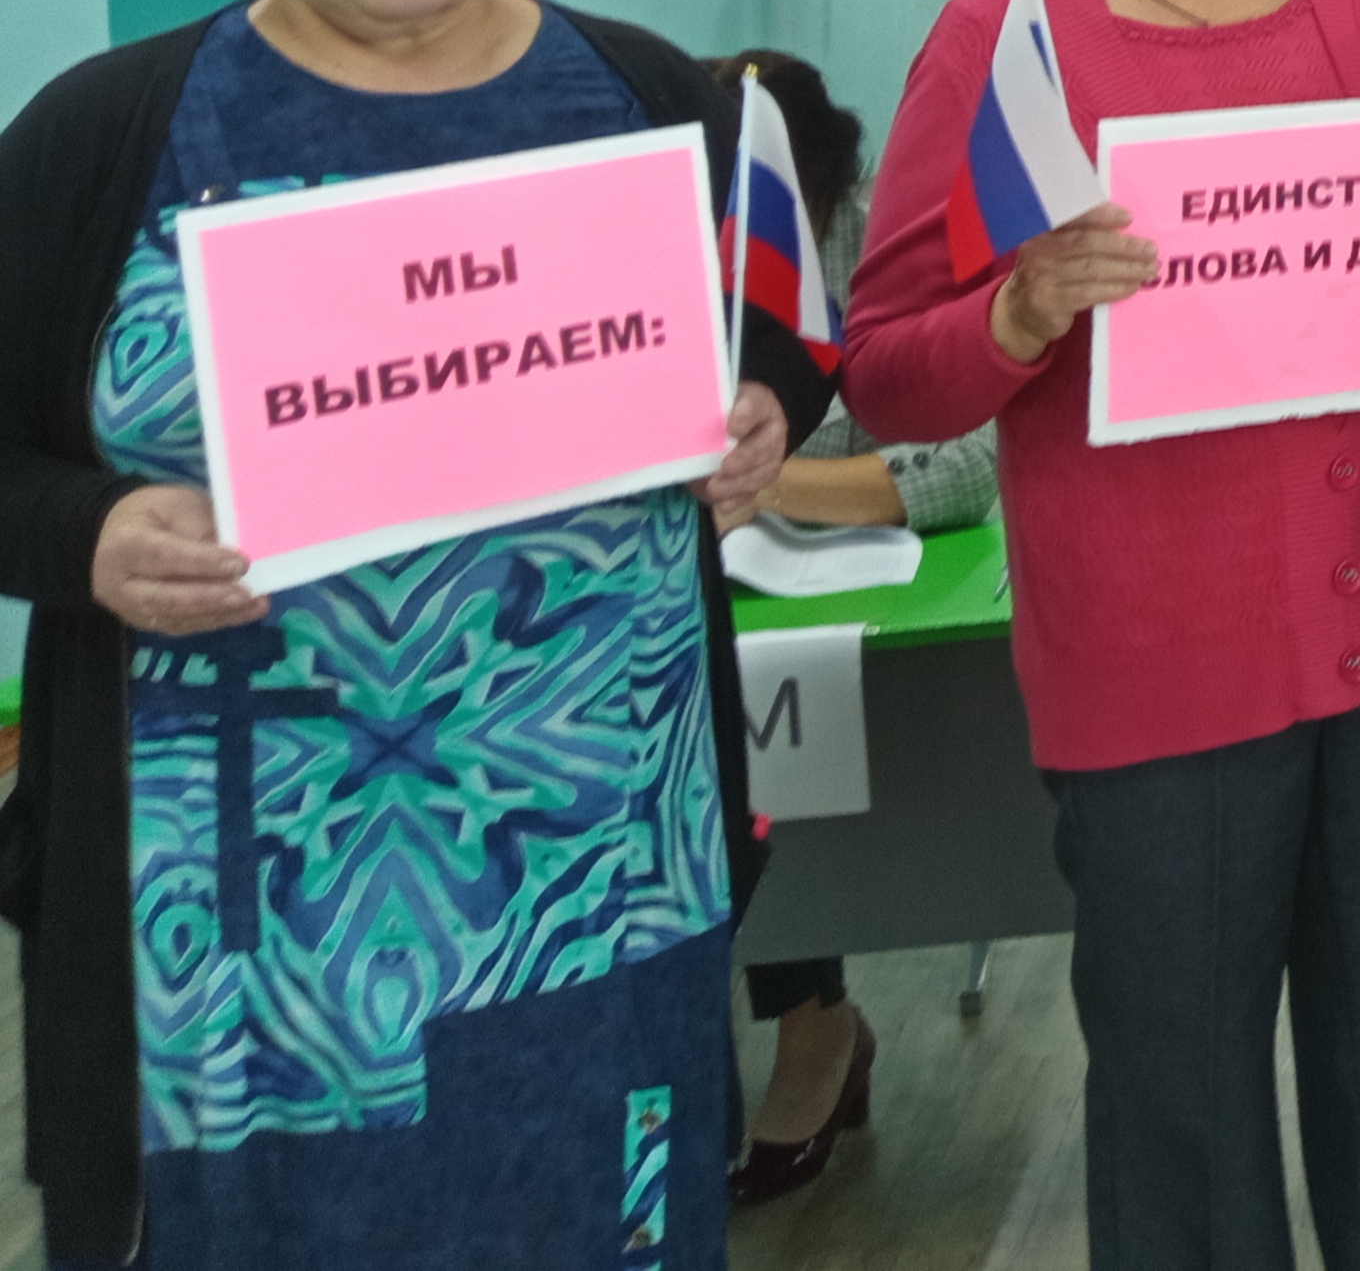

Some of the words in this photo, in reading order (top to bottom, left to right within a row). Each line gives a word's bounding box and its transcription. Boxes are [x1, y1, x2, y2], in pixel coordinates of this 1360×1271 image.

[402, 245, 518, 304] МЫ
[1303, 240, 1332, 272] И
[264, 311, 665, 428] ВЫБИРАЕМ:
